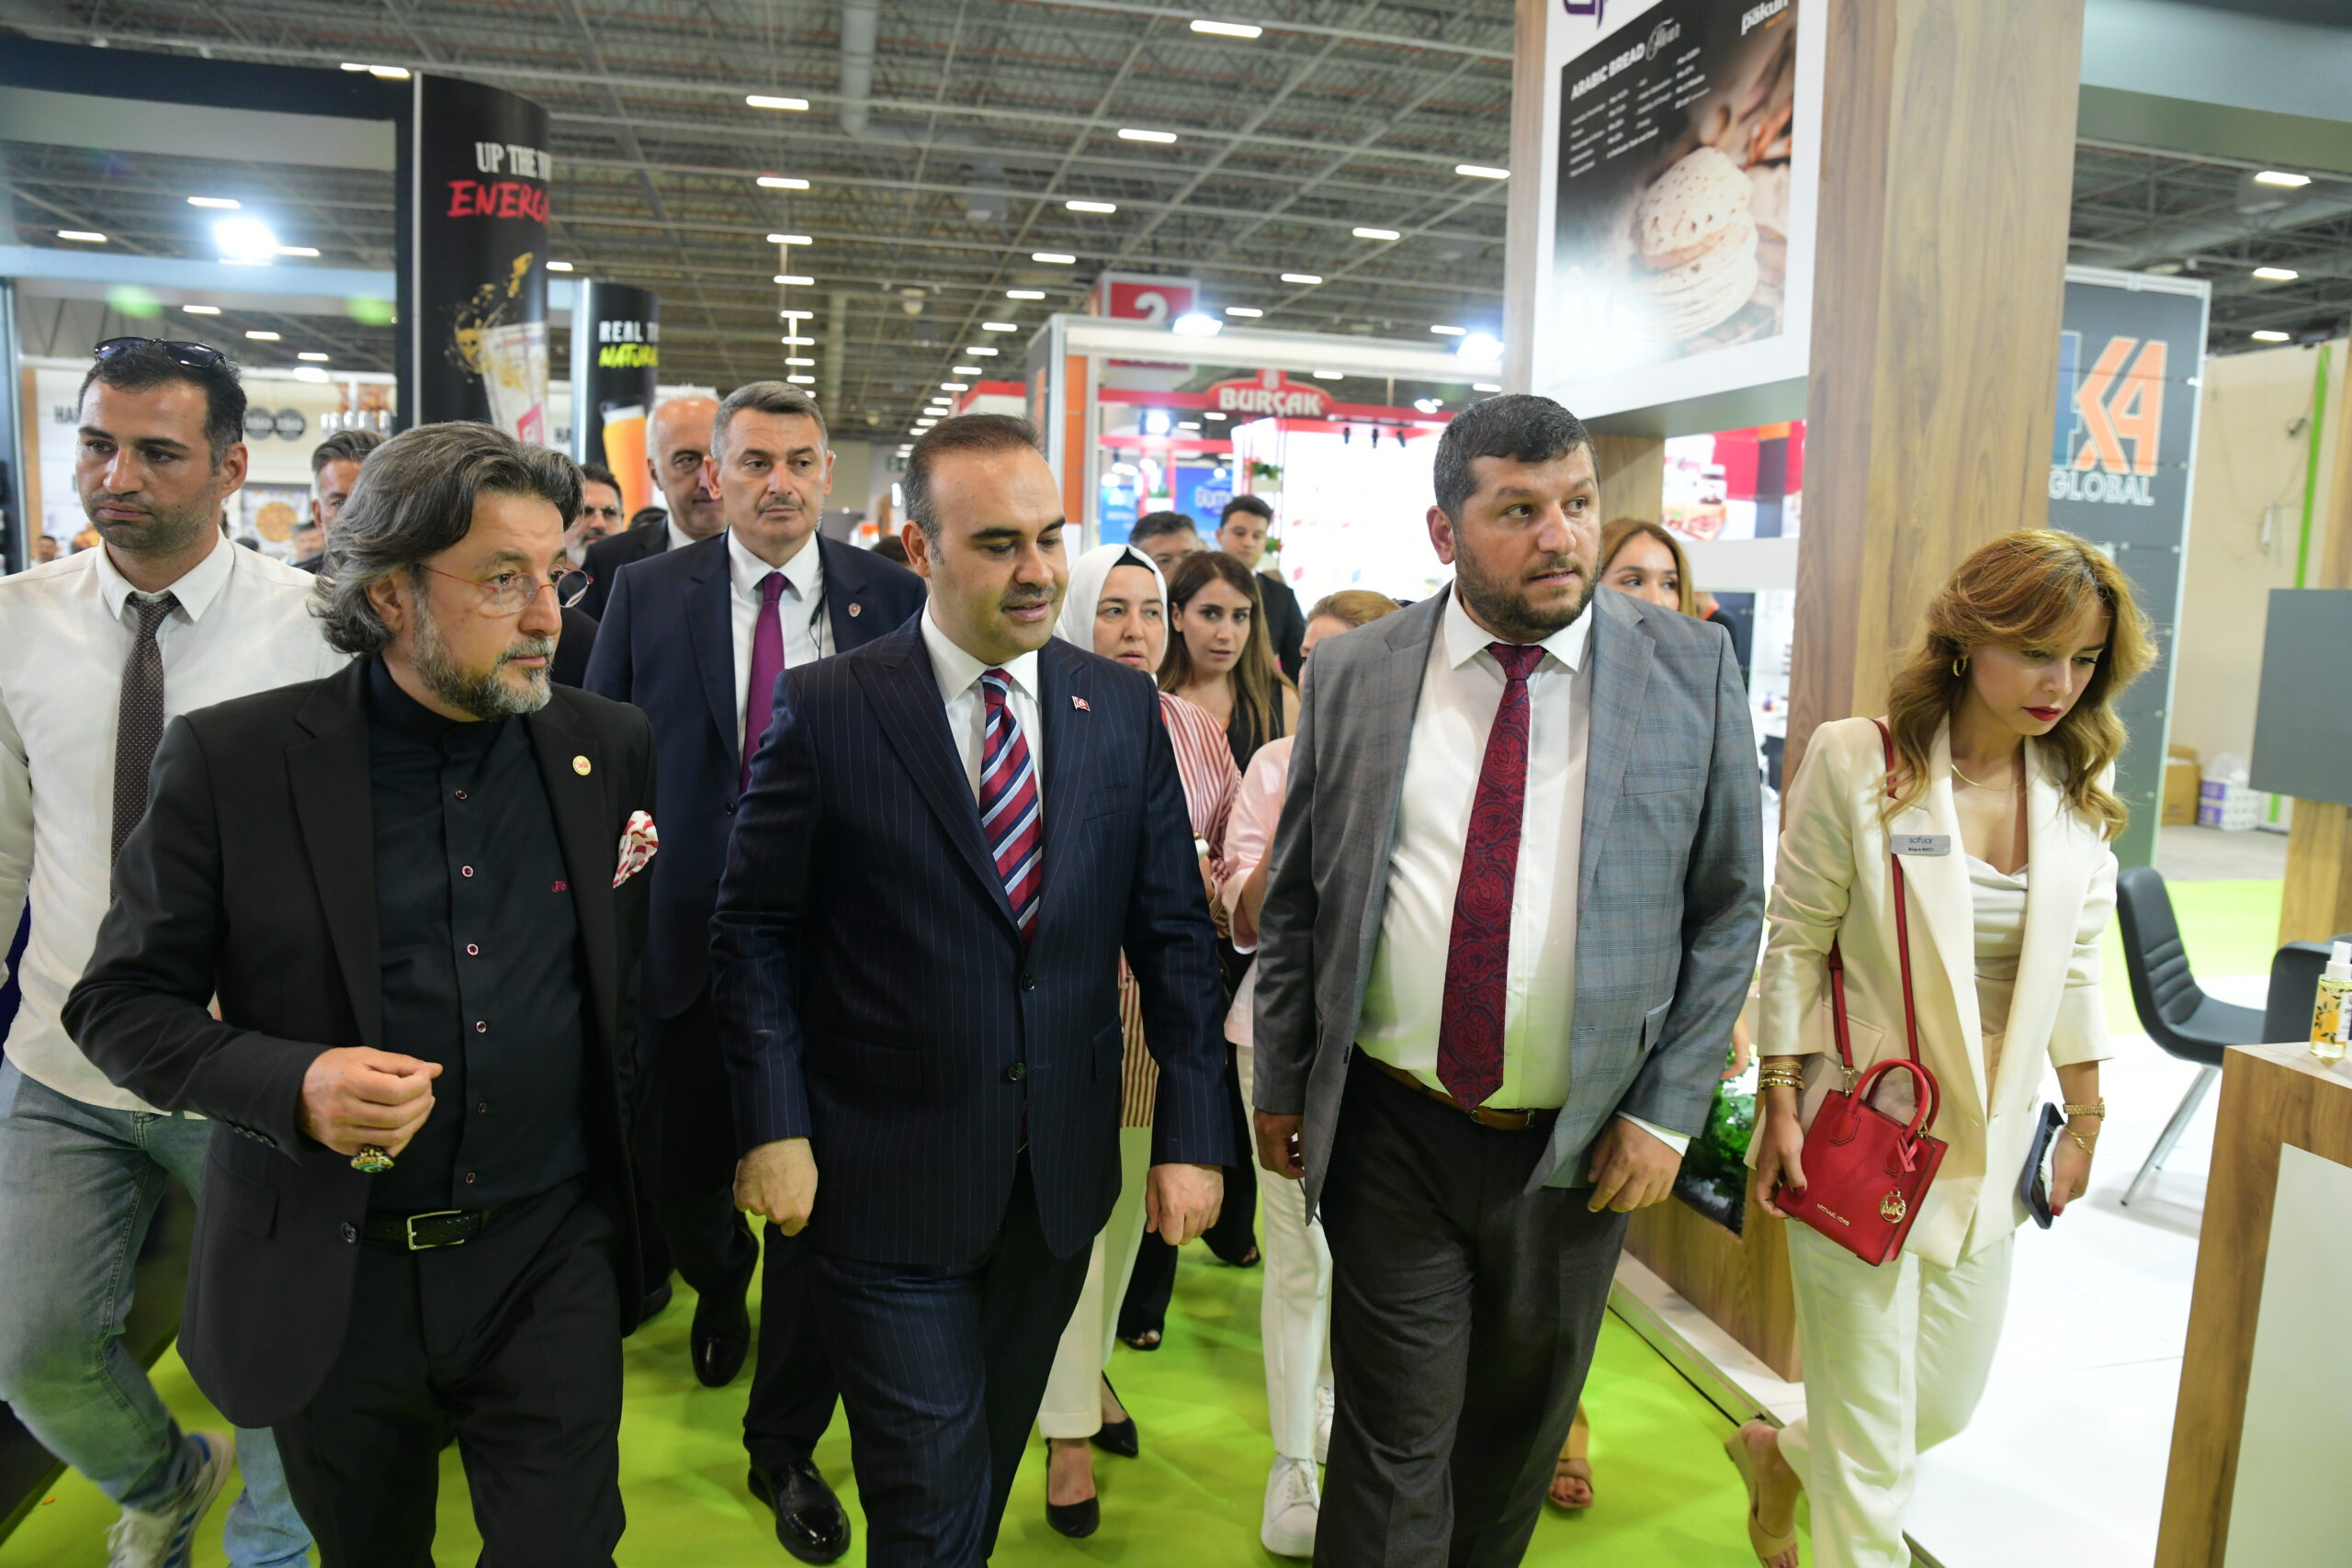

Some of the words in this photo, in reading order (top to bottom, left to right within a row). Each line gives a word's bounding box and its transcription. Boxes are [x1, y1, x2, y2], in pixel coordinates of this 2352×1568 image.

[1570, 64, 1609, 101] ARABIC
[1608, 42, 1645, 77] BREAD
[475, 141, 504, 174] UP
[505, 143, 537, 178] THE
[598, 320, 643, 343] REAL
[1218, 388, 1321, 417] BURÇAK
[2048, 469, 2155, 507] GLOBAL
